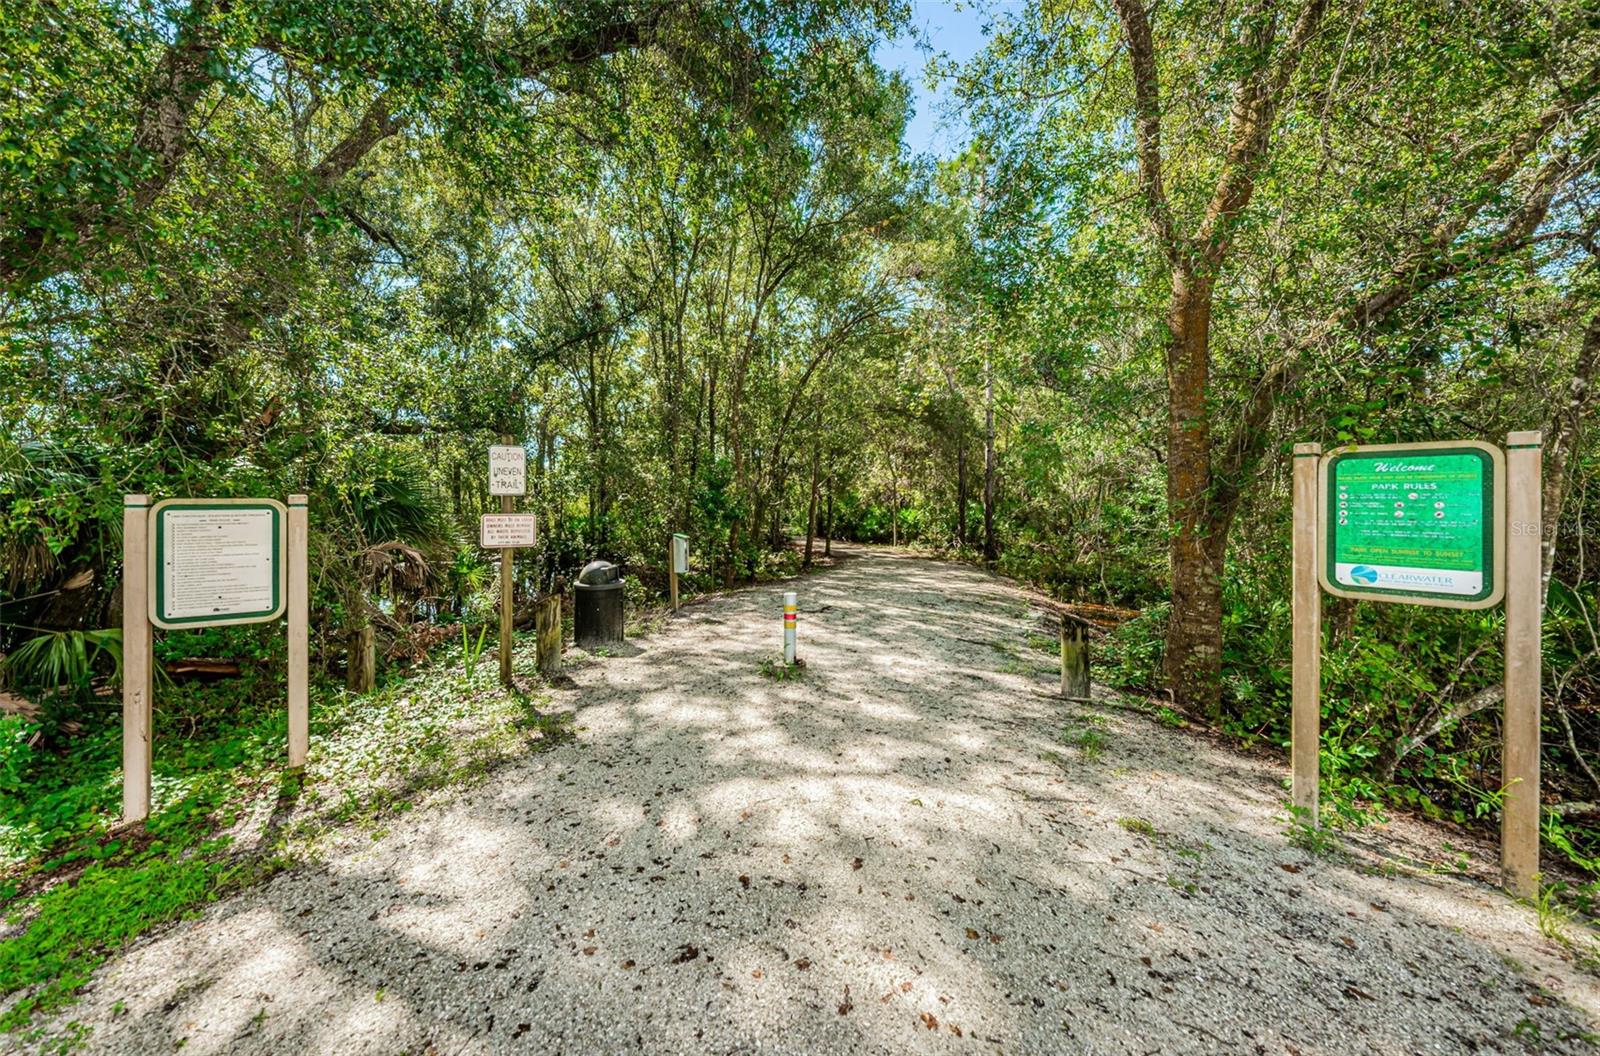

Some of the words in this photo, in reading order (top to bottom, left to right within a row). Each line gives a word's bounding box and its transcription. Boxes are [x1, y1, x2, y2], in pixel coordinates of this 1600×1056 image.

[491, 451, 524, 461] CAUTION
[493, 466, 522, 477] UNEVEN
[1373, 461, 1436, 473] Welcome
[495, 480, 519, 489] TRAIL
[1371, 483, 1399, 491] PARK
[1403, 482, 1437, 490] RULES
[1379, 573, 1453, 584] CLEARWATER
